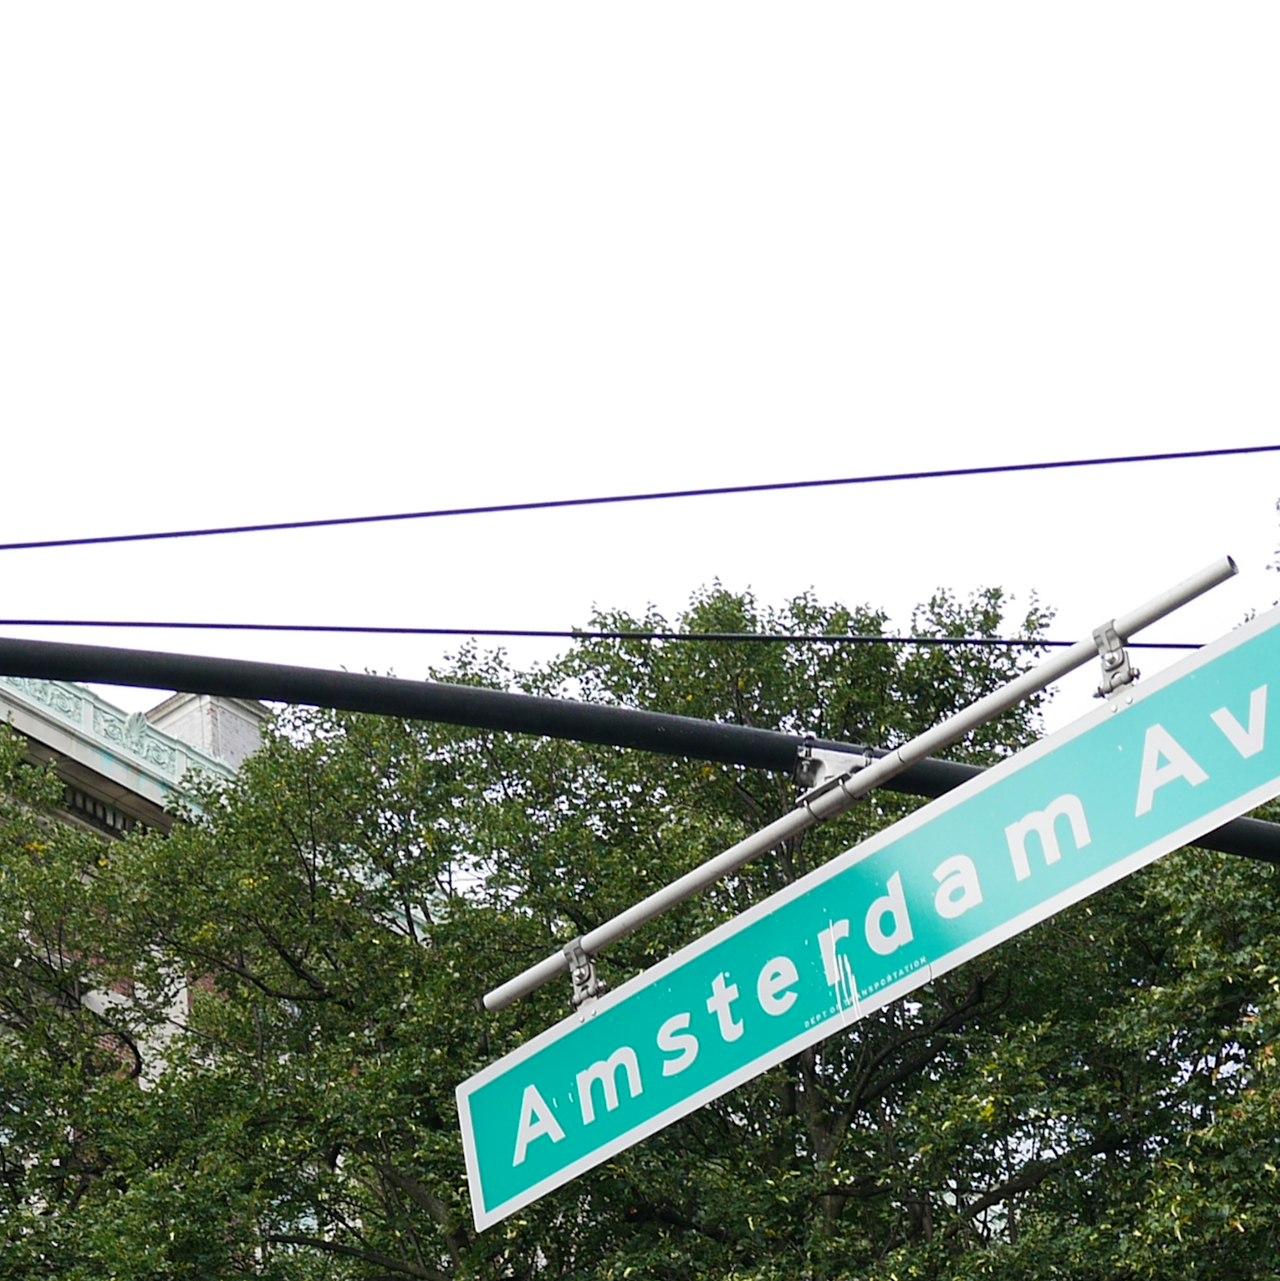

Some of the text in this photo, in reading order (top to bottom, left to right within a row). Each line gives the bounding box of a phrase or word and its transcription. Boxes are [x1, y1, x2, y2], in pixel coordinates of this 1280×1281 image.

[513, 683, 1269, 1166] Amsterdam Av
[804, 1010, 827, 1028] DEPT
